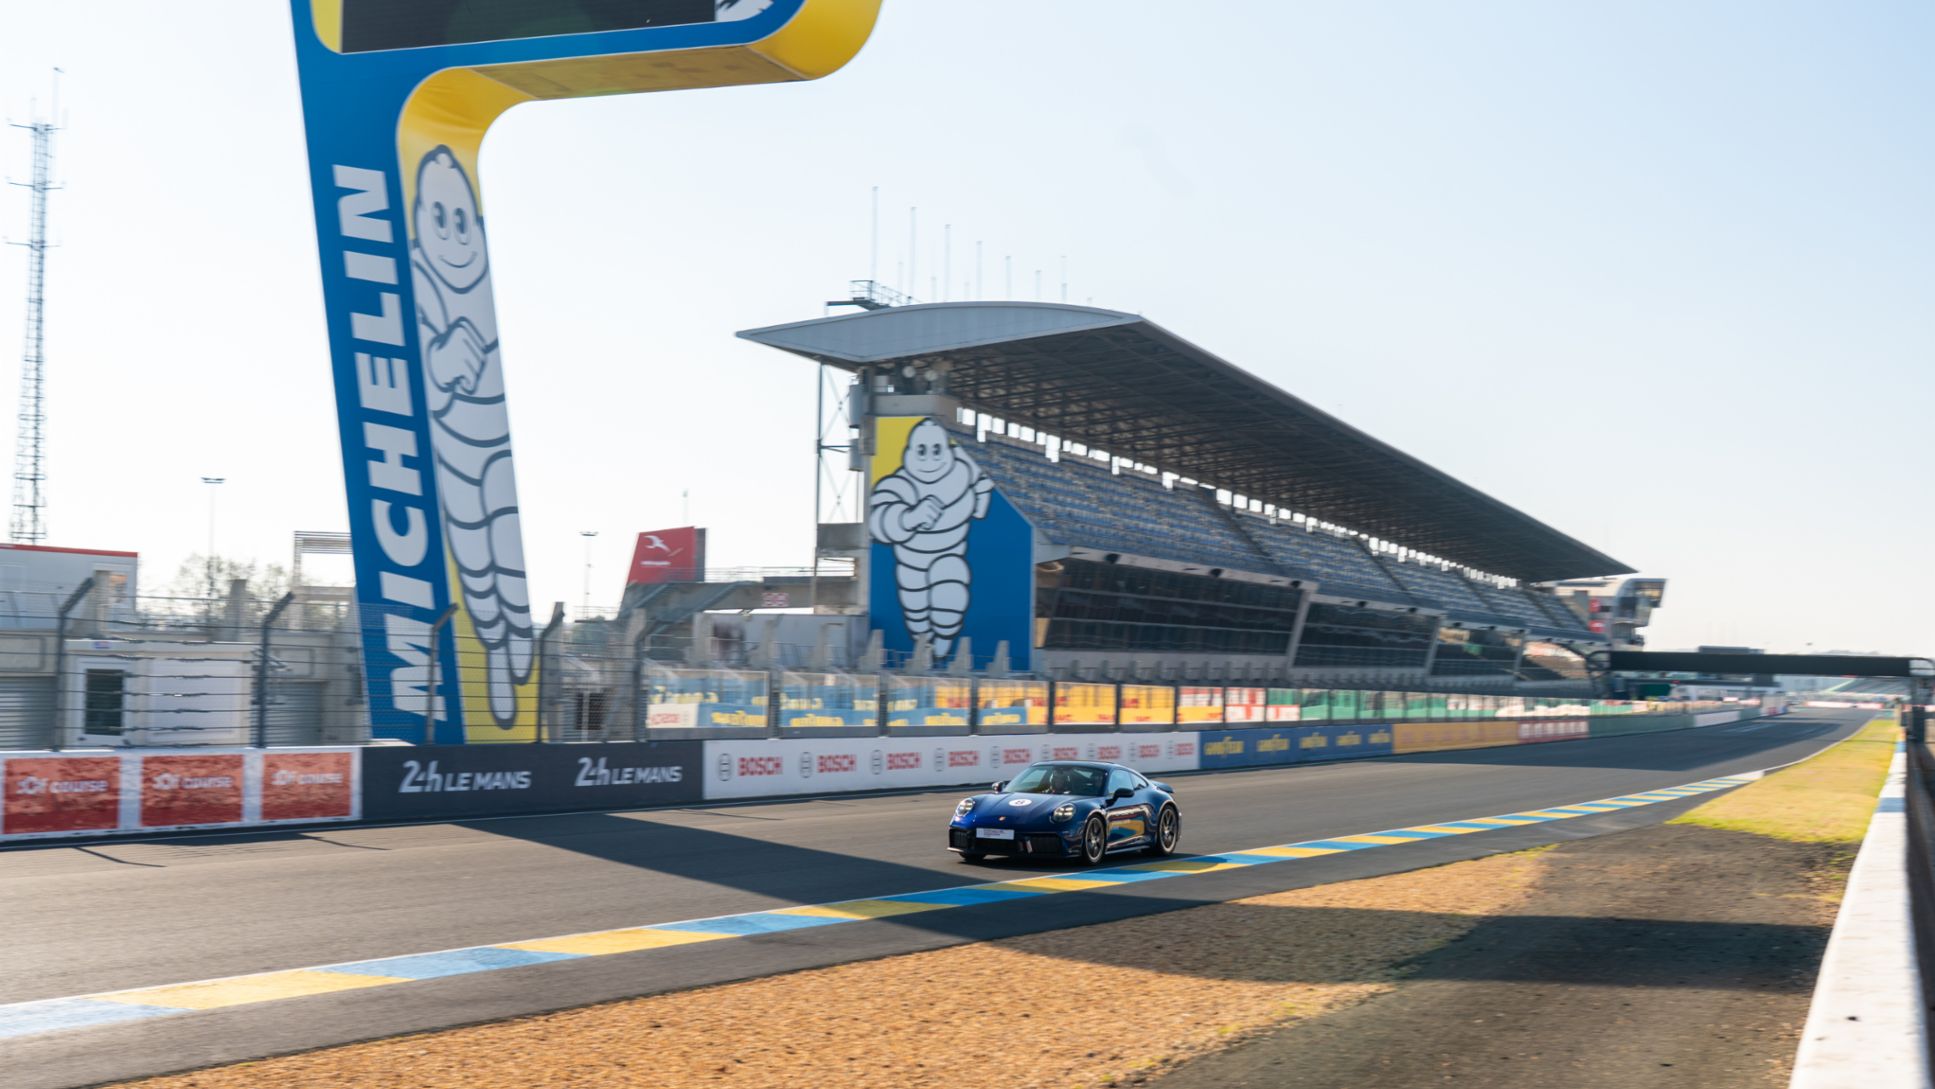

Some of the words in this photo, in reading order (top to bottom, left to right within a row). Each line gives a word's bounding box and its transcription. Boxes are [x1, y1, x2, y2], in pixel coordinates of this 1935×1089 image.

[332, 163, 449, 722] MICHELIN
[399, 760, 442, 793] 24h
[444, 772, 471, 792] LE
[473, 771, 532, 790] MANS
[575, 757, 609, 787] 24h
[612, 767, 635, 785] LE
[637, 765, 683, 784] MANS
